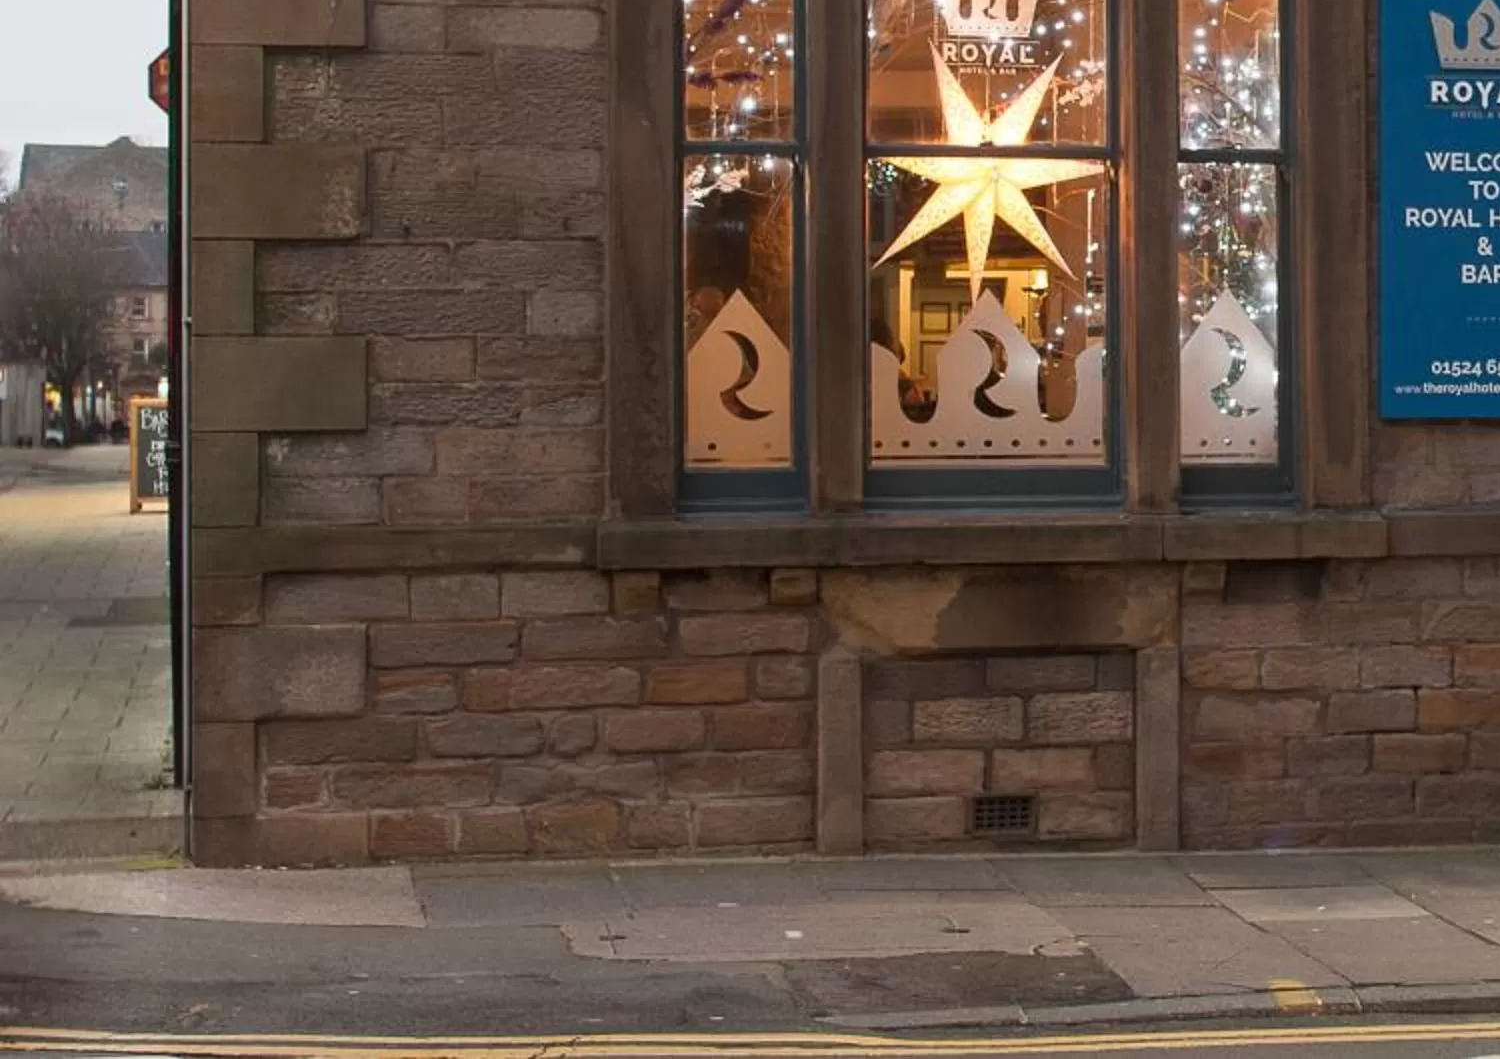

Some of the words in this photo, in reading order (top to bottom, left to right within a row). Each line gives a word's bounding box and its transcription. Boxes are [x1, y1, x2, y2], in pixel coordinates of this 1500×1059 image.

[943, 43, 1035, 67] ROYAL
[1468, 180, 1500, 200] TO
[1405, 207, 1481, 228] ROYAL
[1476, 236, 1494, 256] &
[1431, 360, 1482, 377] 01524
